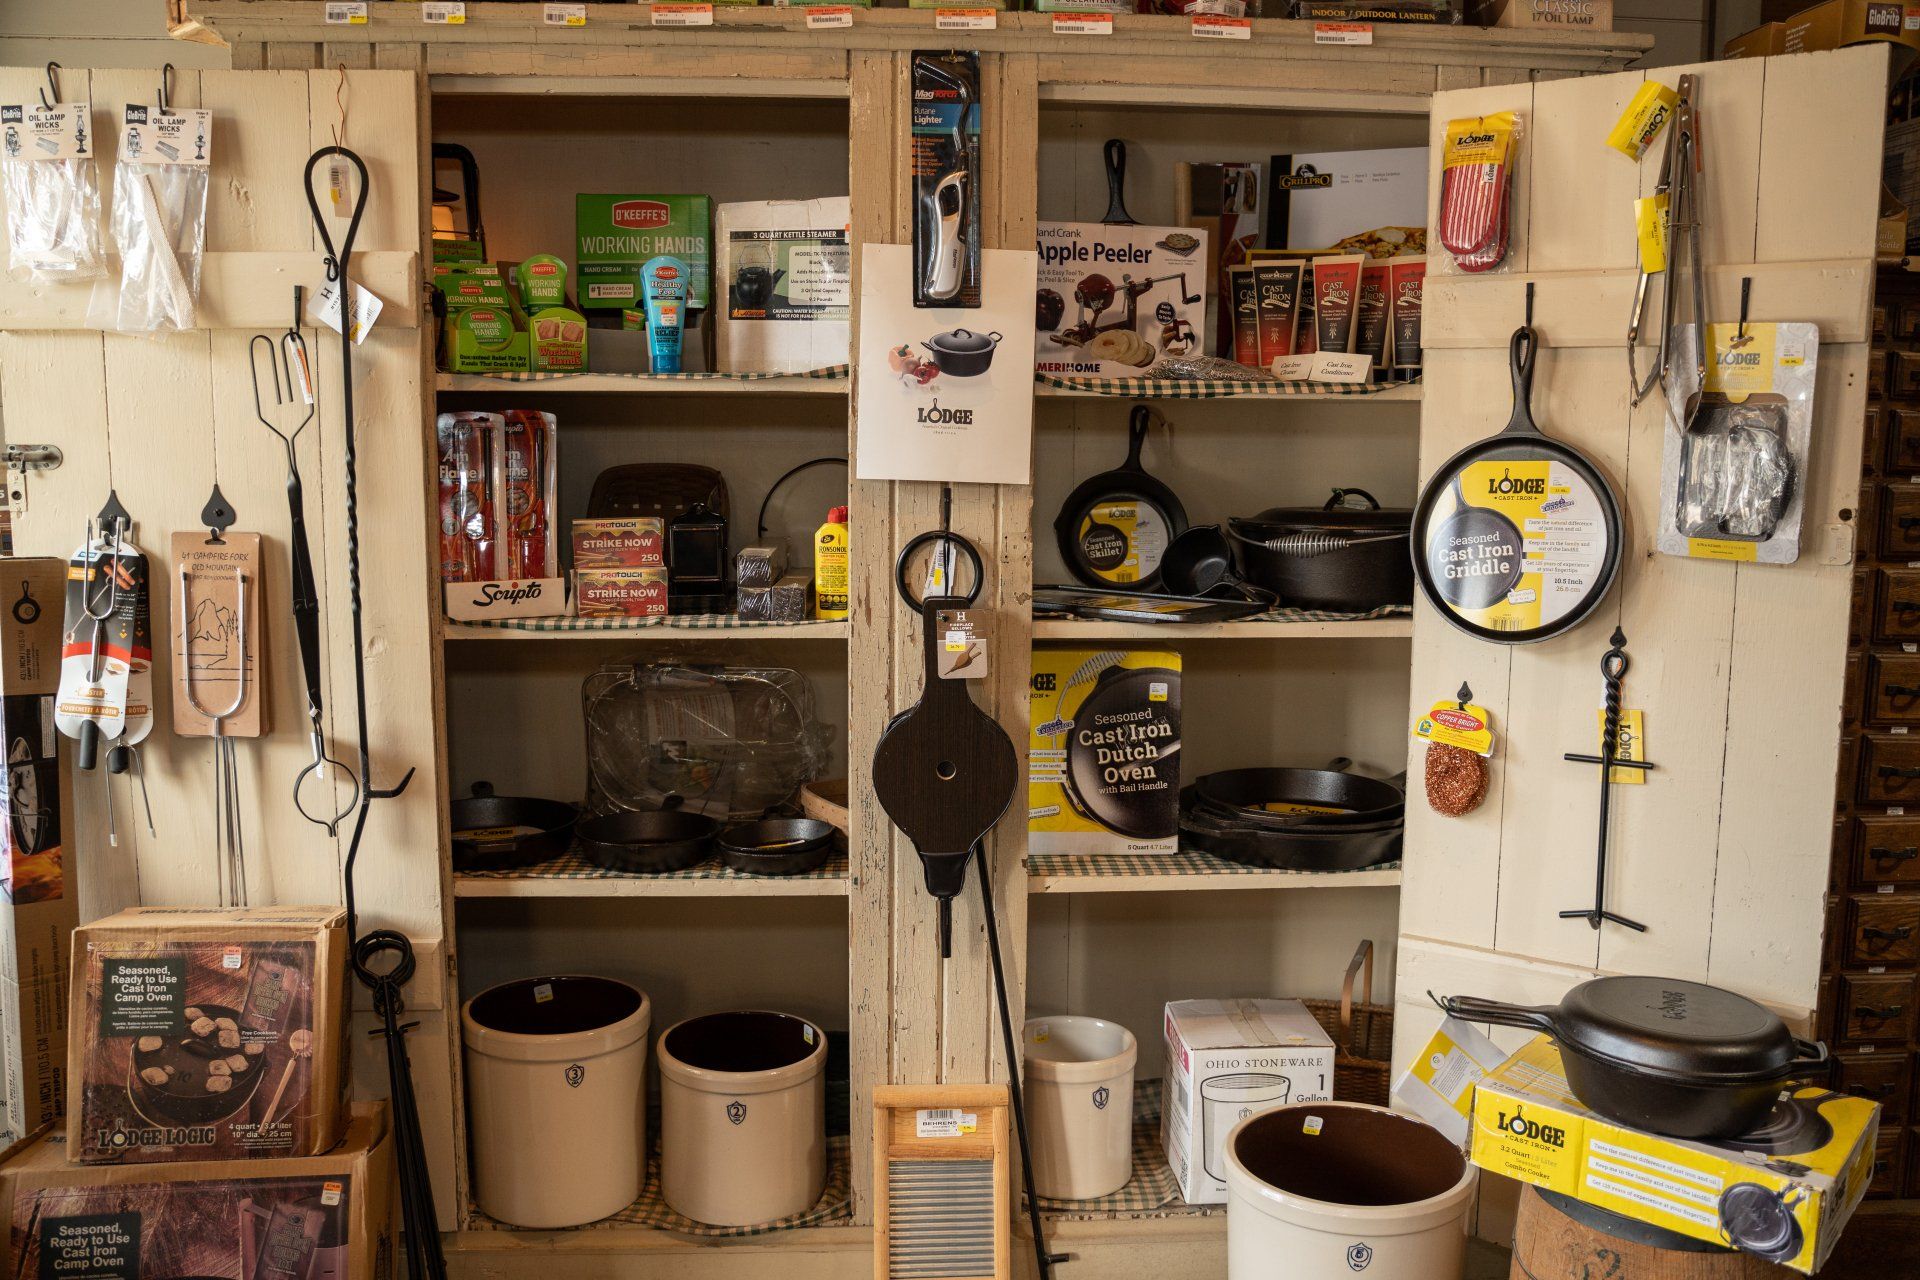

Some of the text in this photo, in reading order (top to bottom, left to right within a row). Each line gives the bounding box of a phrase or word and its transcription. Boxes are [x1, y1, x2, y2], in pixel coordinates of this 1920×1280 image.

[1533, 0, 1593, 15] CLASSIC
[1312, 9, 1436, 20] INDOOR OUTDOOR LANTERN
[1544, 13, 1564, 23] OIL
[1567, 15, 1594, 24] LAMP
[1868, 9, 1900, 26] GloBrite
[914, 89, 959, 99] MagTorch
[2, 107, 22, 119] GloBrite
[28, 114, 42, 122] OIL
[127, 108, 147, 121] GloBrite
[35, 121, 60, 129] WICKS
[914, 116, 943, 124] Lighter
[1457, 132, 1495, 145] LODGE
[1281, 175, 1330, 188] GRILLPRO
[615, 209, 667, 221] O'KEEFFE'S
[807, 230, 837, 238] STEAMER
[1057, 228, 1082, 238] Crank
[582, 237, 705, 254] WORKING HANDS
[1036, 240, 1153, 266] Apple Peeler
[528, 279, 561, 287] WORKING
[652, 280, 683, 289] Healthy
[1322, 282, 1344, 293] CAST
[1399, 282, 1420, 293] CAST
[532, 288, 559, 297] HANDS
[1262, 285, 1284, 295] CAST
[1329, 289, 1350, 298] IRON
[479, 296, 504, 304] HANDS
[1270, 292, 1291, 301] IRON
[474, 328, 500, 336] HANDS
[538, 347, 581, 358] Working
[1716, 350, 1760, 365] LODGE
[549, 356, 582, 364] Hands
[1326, 361, 1339, 369] Cast
[1320, 369, 1355, 377] Conditioner
[917, 403, 973, 425] LODGE
[1488, 474, 1546, 494] LODGE
[1108, 505, 1136, 518] LODGE
[582, 538, 653, 549] STRIKE NOW
[1089, 533, 1115, 543] Seasoned
[1449, 531, 1500, 547] Seasoned
[1085, 543, 1103, 551] Cast
[1439, 543, 1515, 562] Cast Iron
[194, 551, 249, 562] CAMPFIRE FORK
[641, 554, 659, 562] 250
[1089, 547, 1120, 559] Skillet
[191, 563, 239, 572] OLD MOUNTAIN
[1444, 558, 1511, 579] Griddle
[472, 582, 542, 607] Scripto
[587, 588, 658, 598] STRIKE NOW
[646, 604, 665, 612] 250
[1094, 708, 1152, 725] Seasoned
[1436, 713, 1480, 728] COPPER BRIGHT
[1079, 728, 1125, 747] Cast
[1129, 722, 1173, 742] Iron
[1097, 742, 1159, 765] Dutch
[1104, 765, 1156, 784] Oven
[1098, 781, 1168, 794] with Bail Handle
[118, 966, 171, 976] Seasoned,
[111, 975, 178, 985] Ready to Use
[121, 984, 167, 992] Cast Iron
[114, 993, 173, 1003] Camp Oven
[1206, 1057, 1324, 1069] OHIO STONEWARE
[37, 1037, 51, 1104] INCH CM
[570, 1068, 579, 1079] 3
[53, 1067, 61, 1097] TRIPOD
[1318, 1073, 1325, 1091] 1
[1296, 1094, 1329, 1103] Gallon
[732, 1106, 741, 1117] 2
[235, 1123, 256, 1131] quart
[1497, 1107, 1566, 1148] LODGE
[98, 1122, 163, 1149] LODGE
[164, 1127, 216, 1146] LOGIC
[268, 1130, 279, 1138] 25
[1509, 1135, 1551, 1152] CAST IRON
[1500, 1145, 1531, 1159] 3.2 Quart
[1594, 1142, 1607, 1150] Taste
[1608, 1146, 1618, 1154] the
[1618, 1148, 1638, 1160] natural
[1638, 1154, 1665, 1169] difference
[1673, 1166, 1684, 1175] just
[1684, 1169, 1696, 1178] iron
[1696, 1173, 1708, 1182] and
[1504, 1161, 1550, 1180] Combo Cooker
[59, 1223, 122, 1237] Seasoned,
[50, 1233, 130, 1249] Ready to Use
[62, 1246, 117, 1258] Cast Iron
[1355, 1248, 1364, 1260] 5
[54, 1256, 124, 1271] Camp Oven
